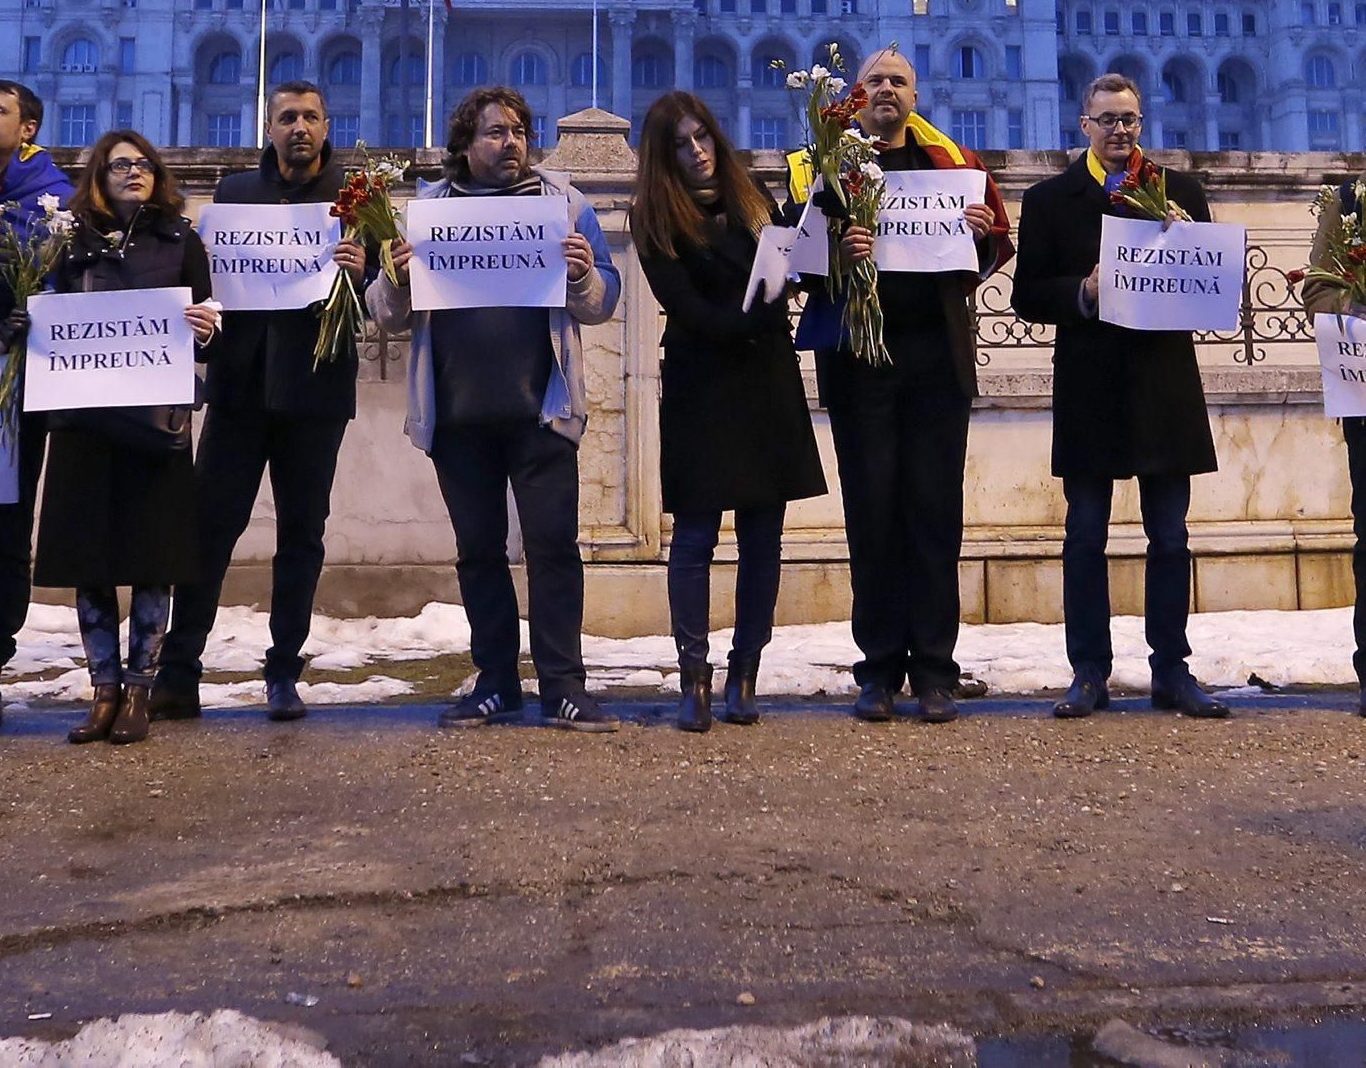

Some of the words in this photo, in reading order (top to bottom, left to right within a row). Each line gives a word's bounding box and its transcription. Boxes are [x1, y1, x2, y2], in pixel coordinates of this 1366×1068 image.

[876, 192, 965, 210] ZISTĂM
[214, 227, 321, 246] REZISTĂM
[430, 221, 545, 242] REZISTĂM
[875, 218, 966, 237] PREUNĂ
[212, 254, 322, 274] ÎMPREUNĂ
[428, 249, 546, 271] ÎMPREUNĂ
[1116, 245, 1223, 267] REZISTĂM
[1114, 269, 1221, 295] ÎMPREUNĂ
[50, 315, 170, 341] REZISTĂM
[49, 345, 172, 372] ÎMPREUNĂ
